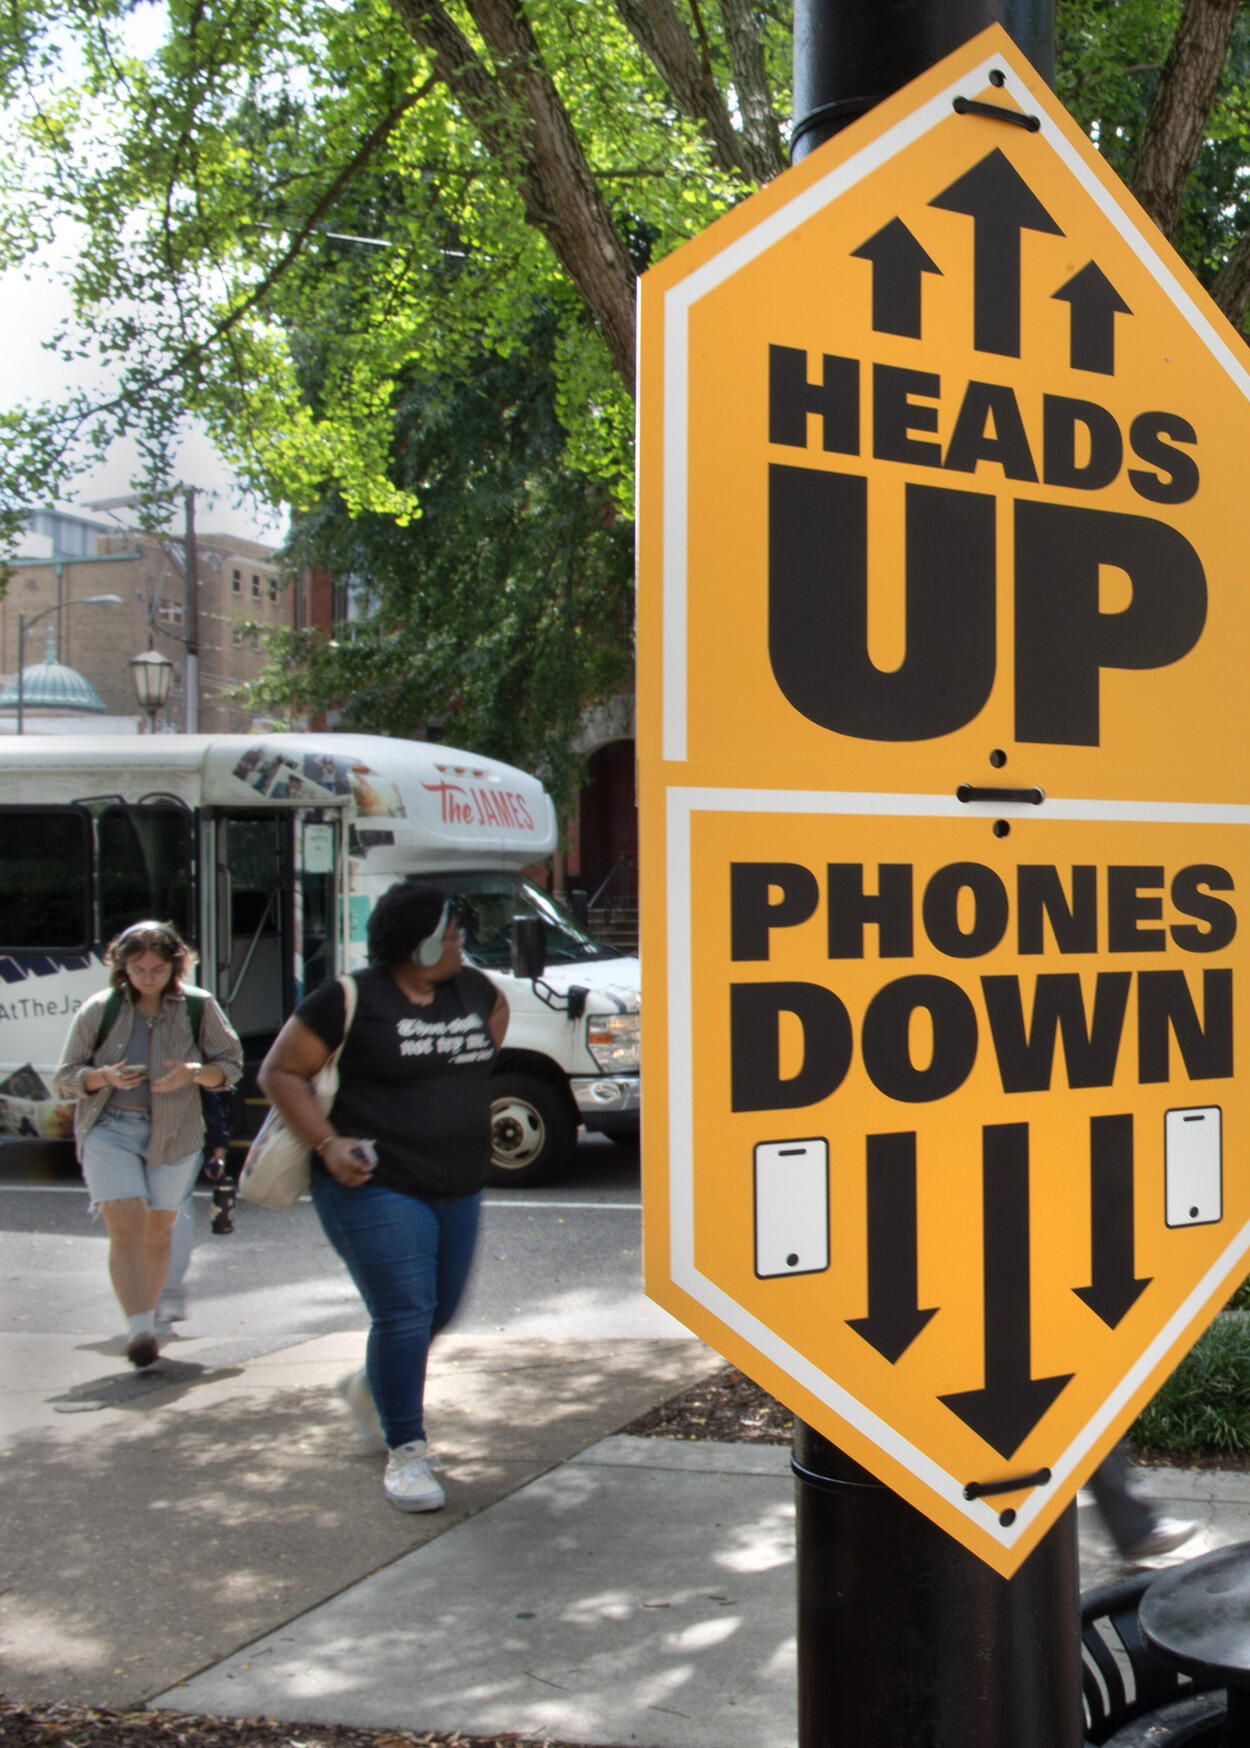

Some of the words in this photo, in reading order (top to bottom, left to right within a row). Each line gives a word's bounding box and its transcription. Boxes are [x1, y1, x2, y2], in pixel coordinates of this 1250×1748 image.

[769, 343, 1200, 505] HEADS
[768, 462, 1208, 747] UP
[420, 780, 474, 824] The
[470, 787, 534, 831] JAMES
[730, 861, 1237, 962] PHONES
[730, 968, 1234, 1113] DOWN
